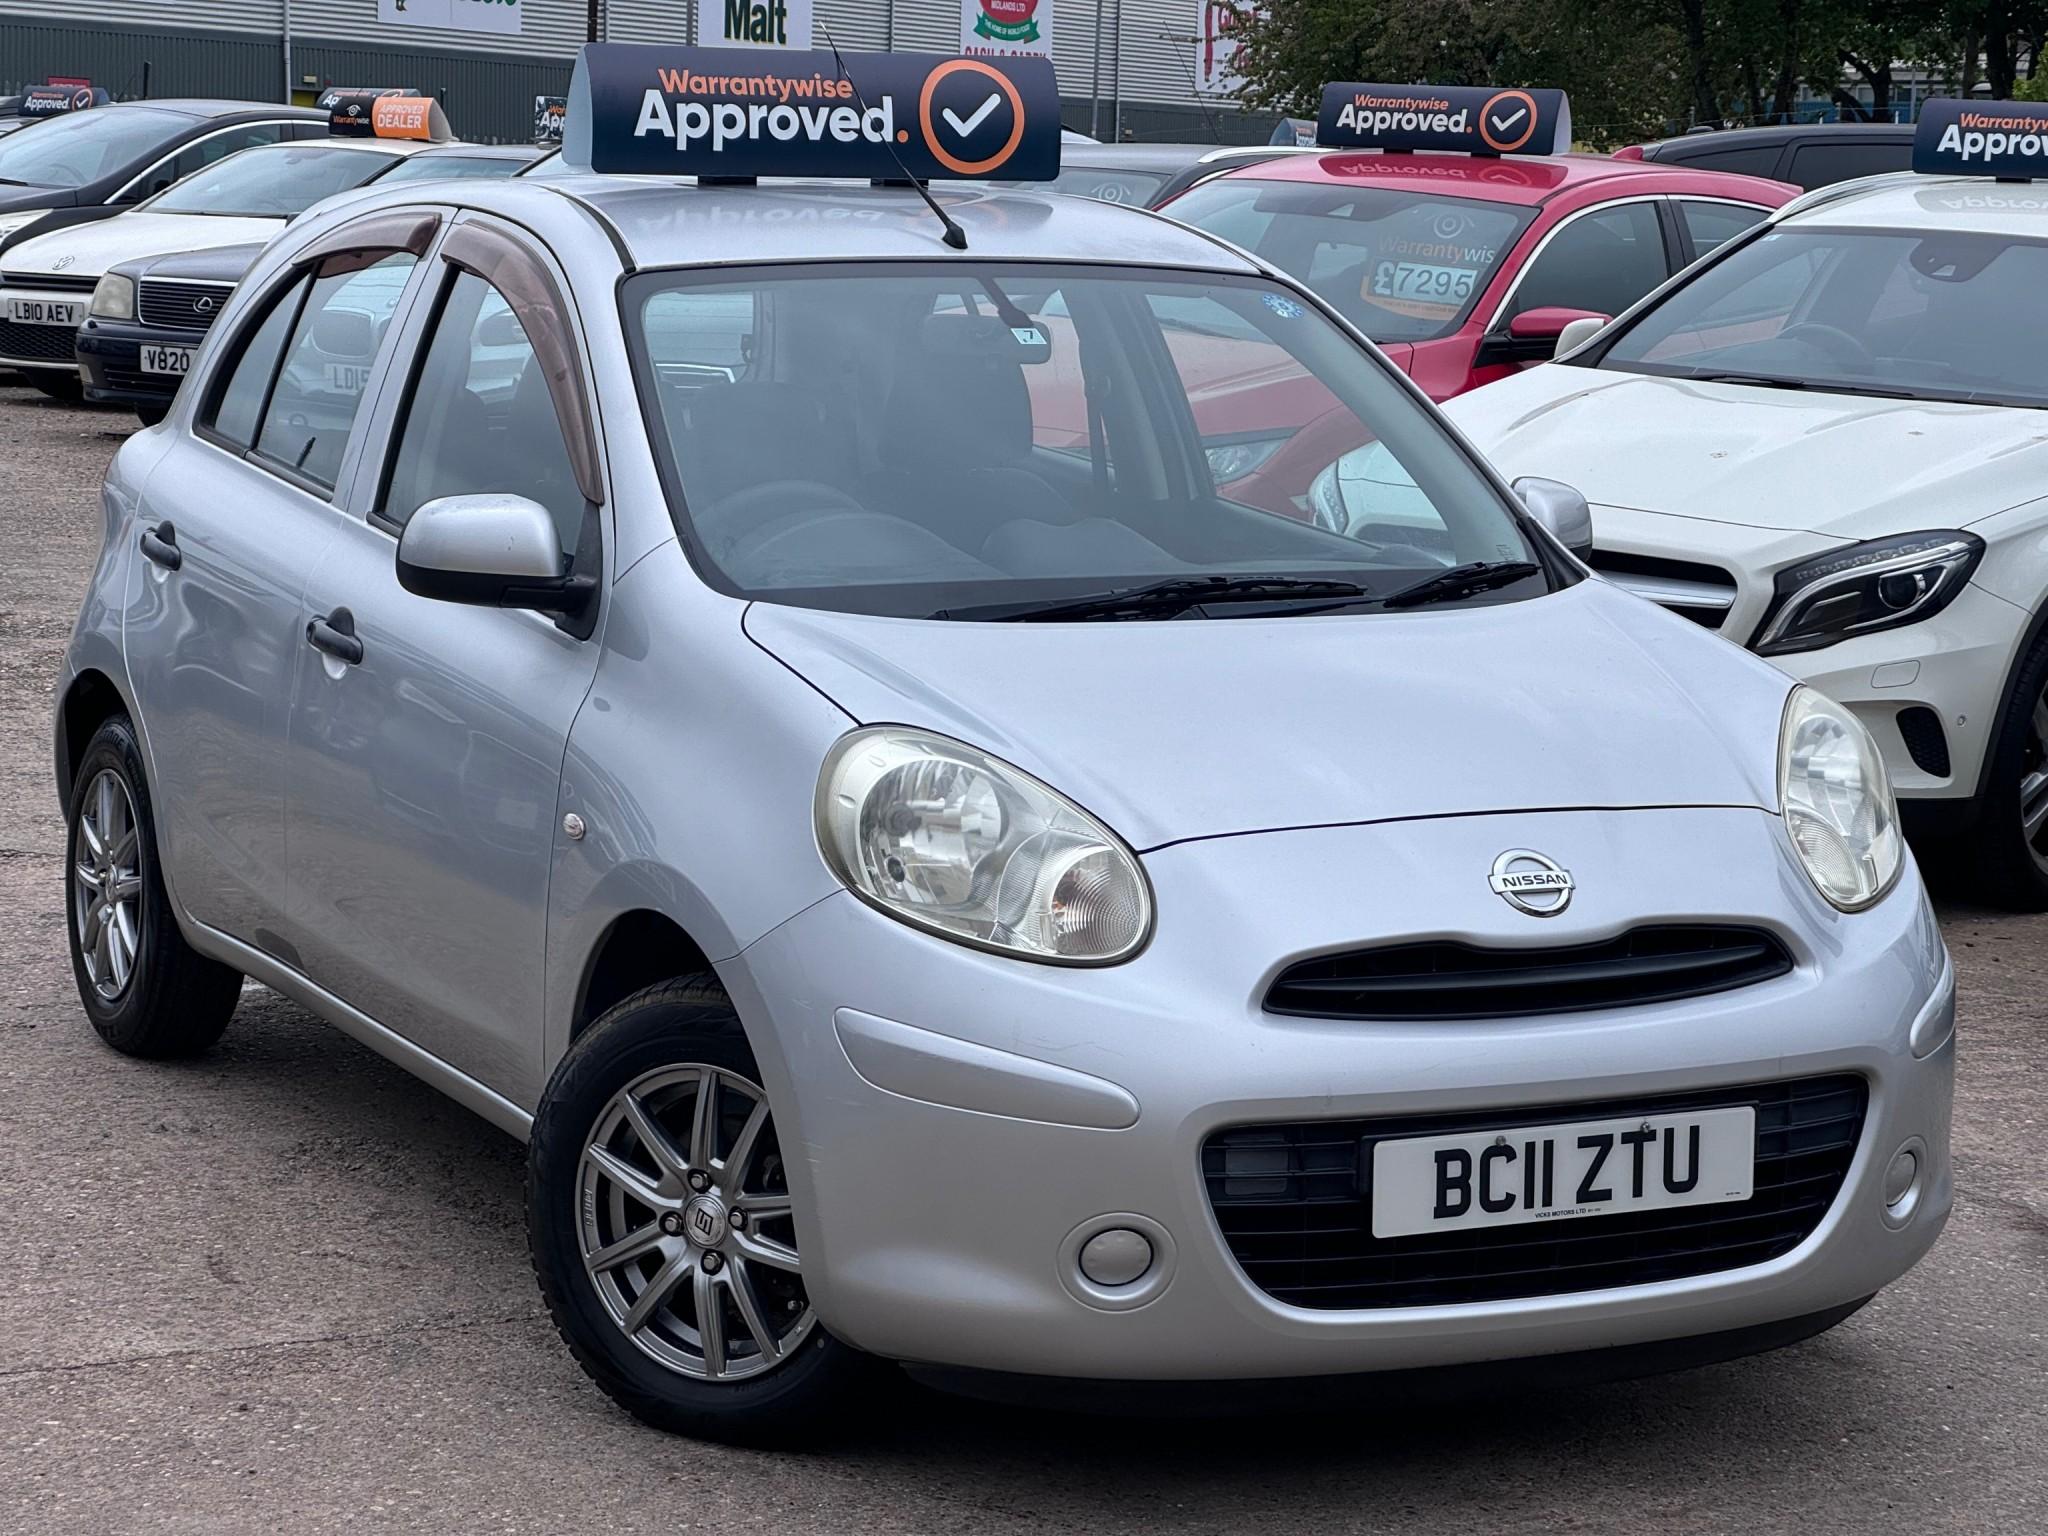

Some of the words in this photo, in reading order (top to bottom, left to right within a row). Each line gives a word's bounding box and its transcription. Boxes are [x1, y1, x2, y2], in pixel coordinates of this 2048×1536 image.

[724, 0, 786, 44] Malt
[658, 68, 853, 102] Warrantywise
[379, 104, 424, 114] APPROVED
[1355, 94, 1449, 111] Warrantywise
[333, 115, 369, 126] Warrantywise
[377, 114, 422, 129] DEALER
[634, 89, 909, 151] Approved.
[1336, 103, 1473, 136] Approved.
[1378, 231, 1496, 263] Warrantywis
[1374, 261, 1473, 299] £7295
[14, 301, 43, 321] LB10
[46, 303, 74, 323] AEV
[147, 350, 190, 372] V820
[1501, 874, 1568, 888] NISSAN
[1433, 1138, 1555, 1220] BC11
[1575, 1124, 1700, 1205] ZTU
[1535, 1211, 1551, 1219] VICKS
[1552, 1209, 1575, 1217] MOTORS
[1576, 1207, 1587, 1215] LTD
